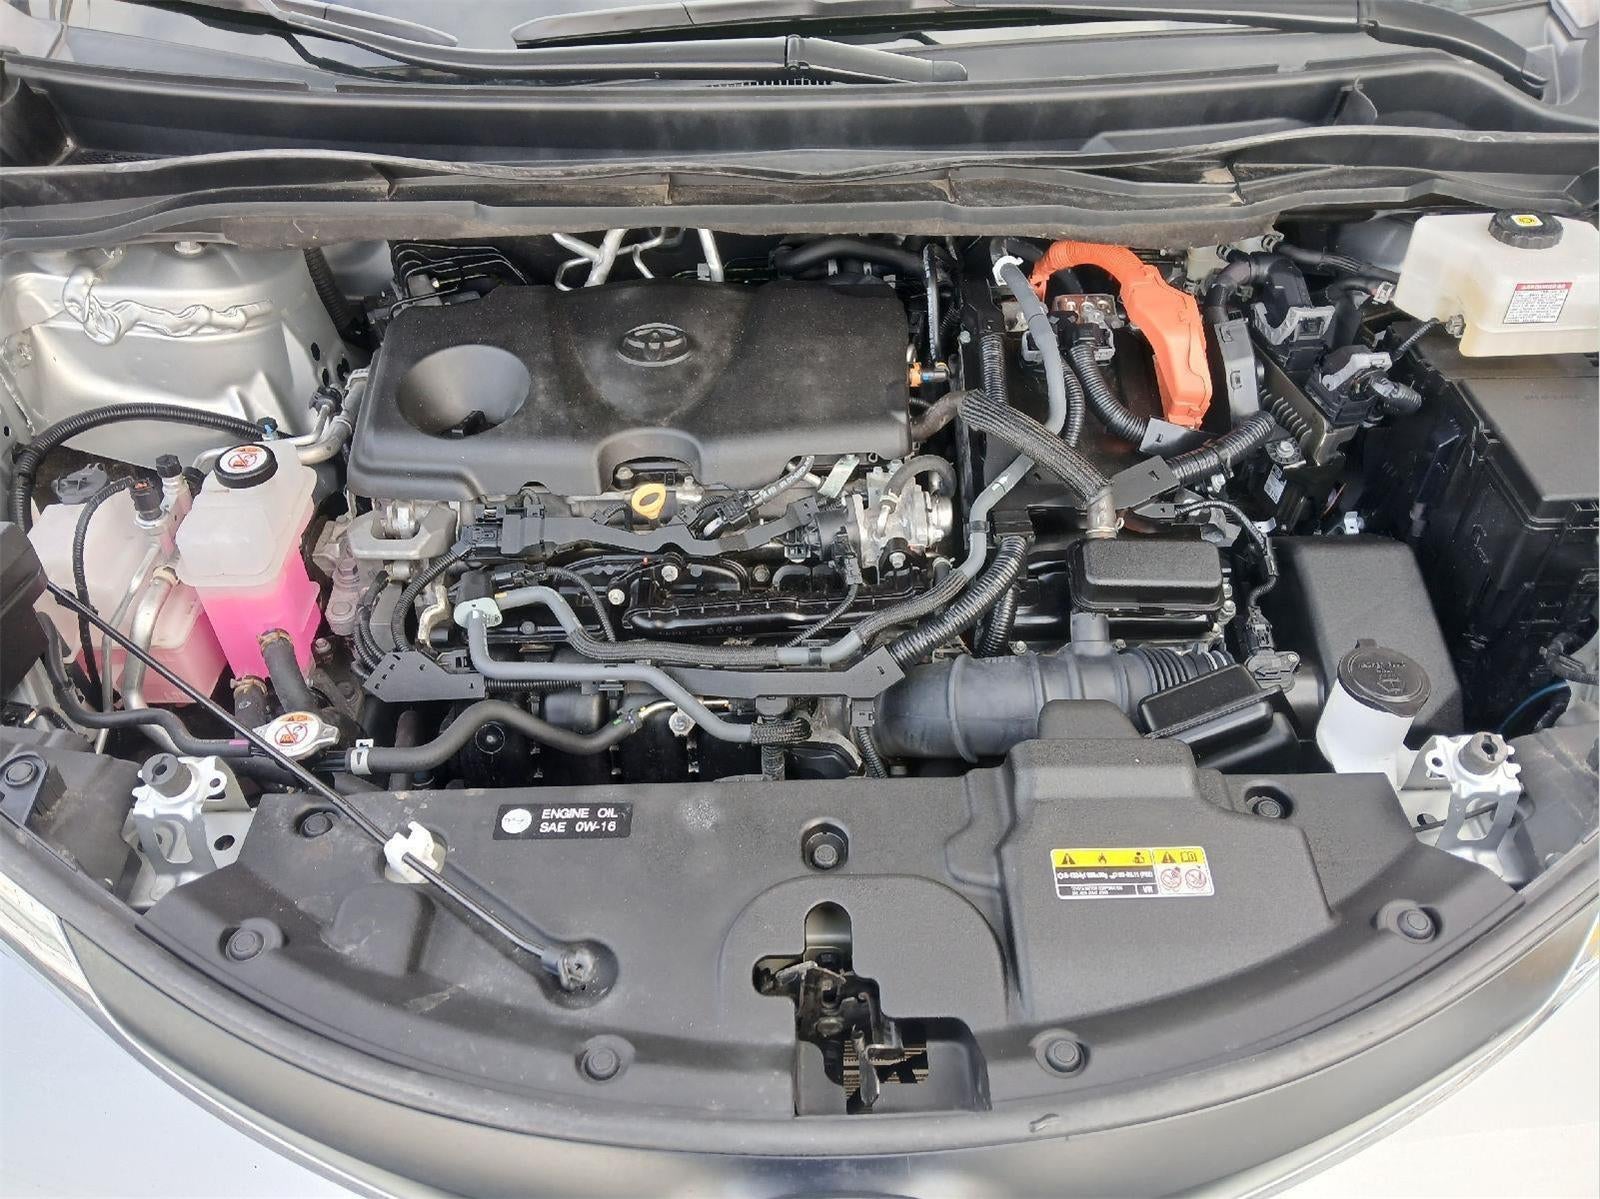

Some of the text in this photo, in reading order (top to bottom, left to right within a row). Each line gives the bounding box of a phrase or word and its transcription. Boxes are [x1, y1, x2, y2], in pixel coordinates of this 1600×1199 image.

[541, 808, 618, 819] ENGINE OIL
[539, 821, 616, 833] SAE 0W-16
